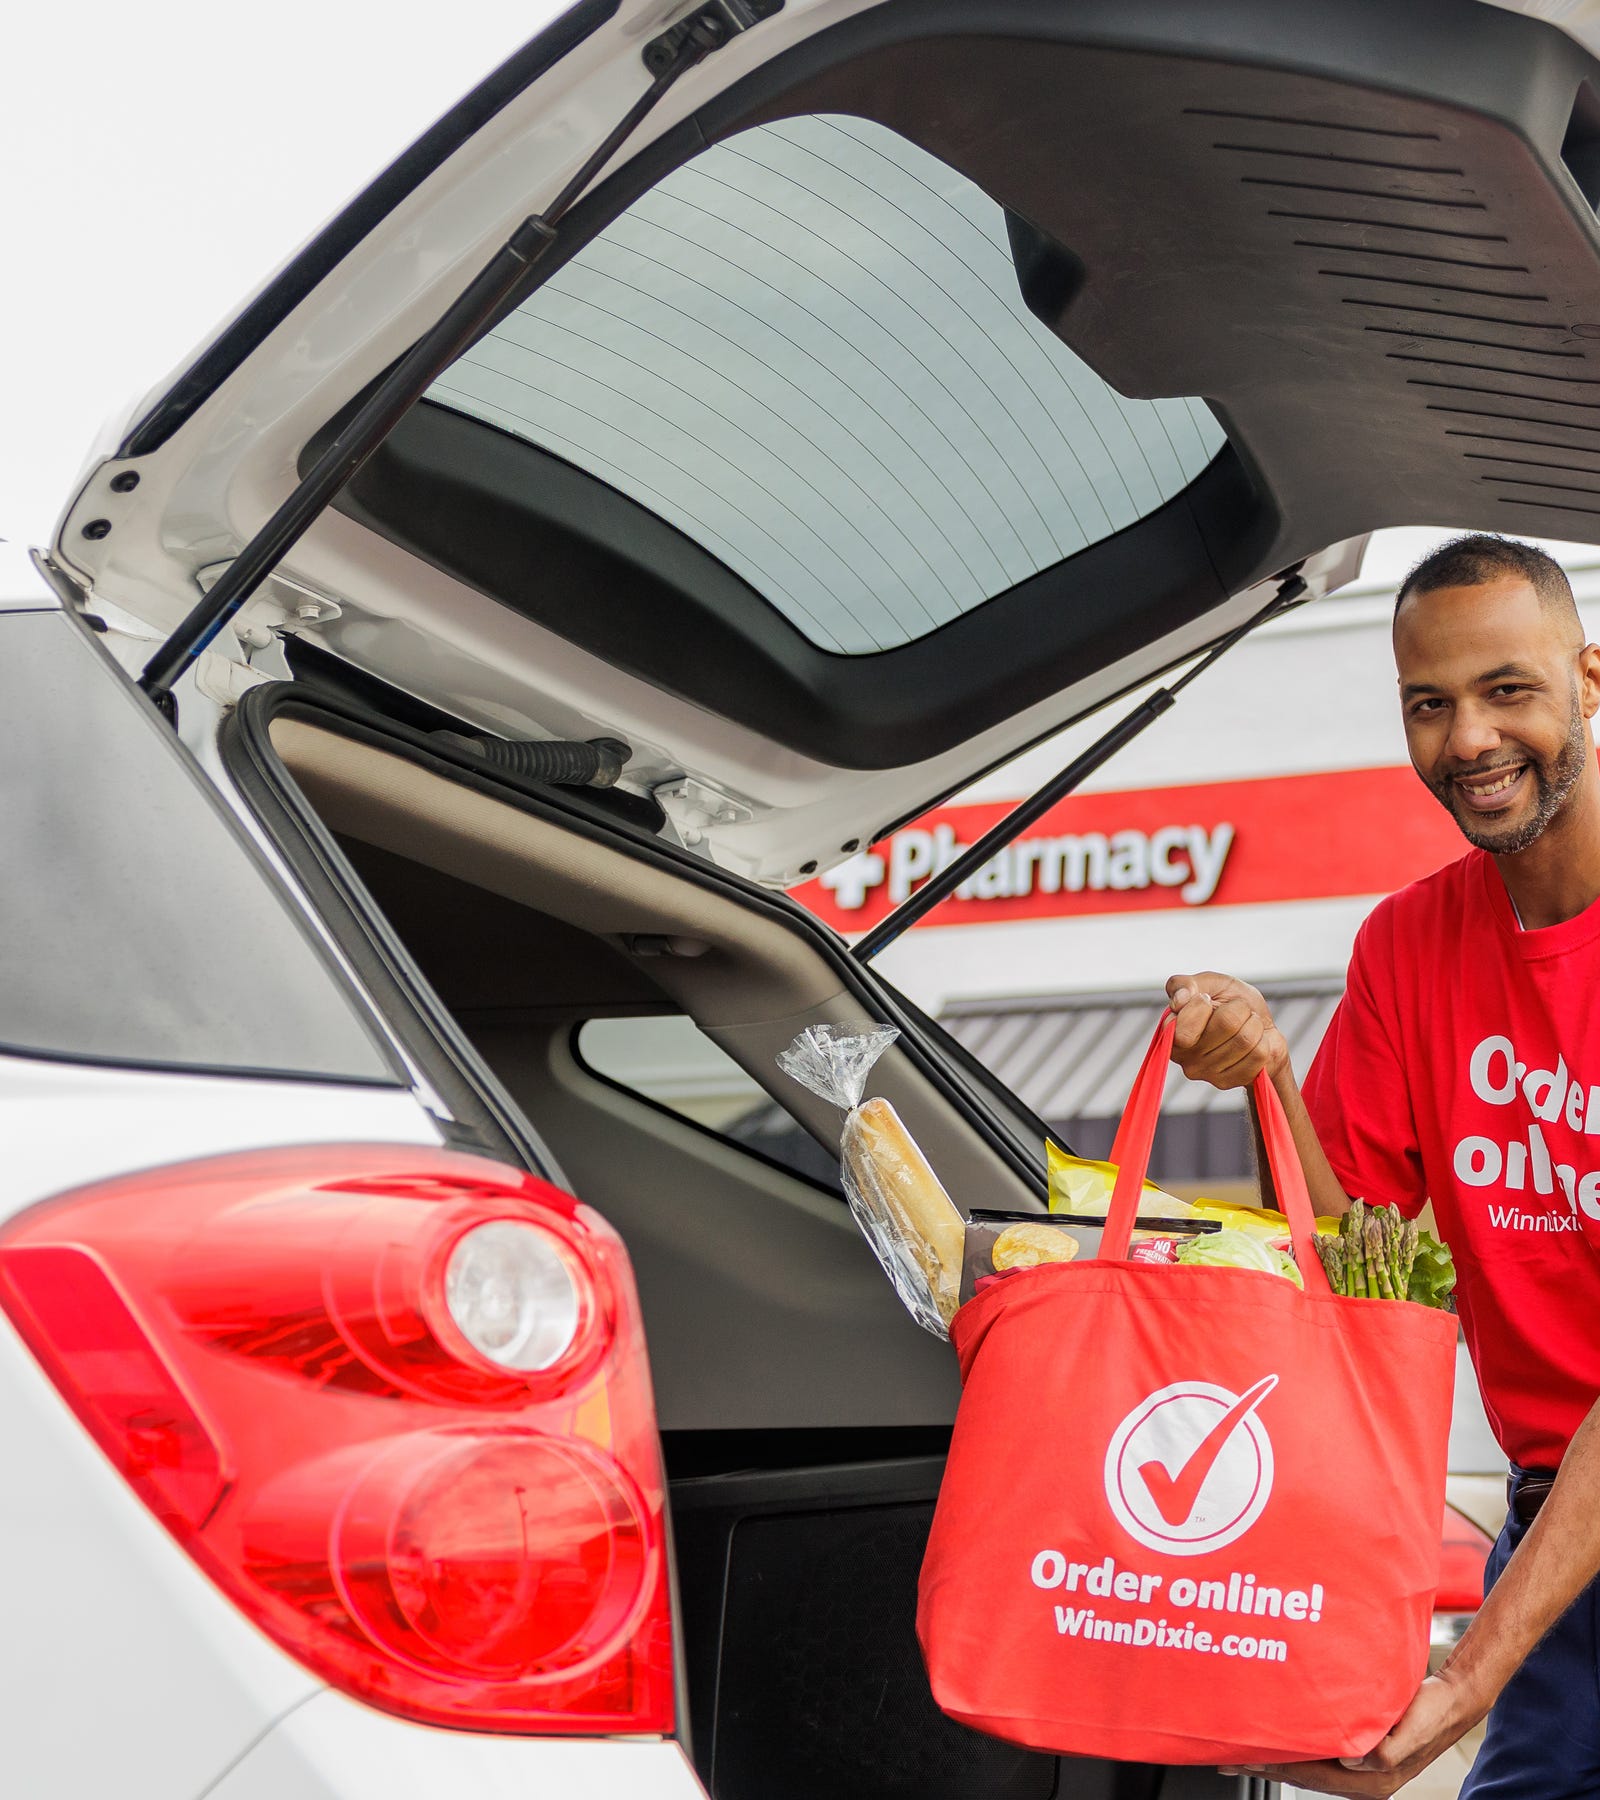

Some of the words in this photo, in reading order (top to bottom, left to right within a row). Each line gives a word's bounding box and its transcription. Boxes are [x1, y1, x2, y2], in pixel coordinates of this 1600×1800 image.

[888, 822, 1235, 905] Pharmacy
[1153, 1240, 1171, 1254] NO
[1487, 1204, 1584, 1233] Winnixi
[1031, 1549, 1163, 1604] Order
[1169, 1572, 1324, 1622] online!
[1054, 1605, 1288, 1662] WinnDixie.com
